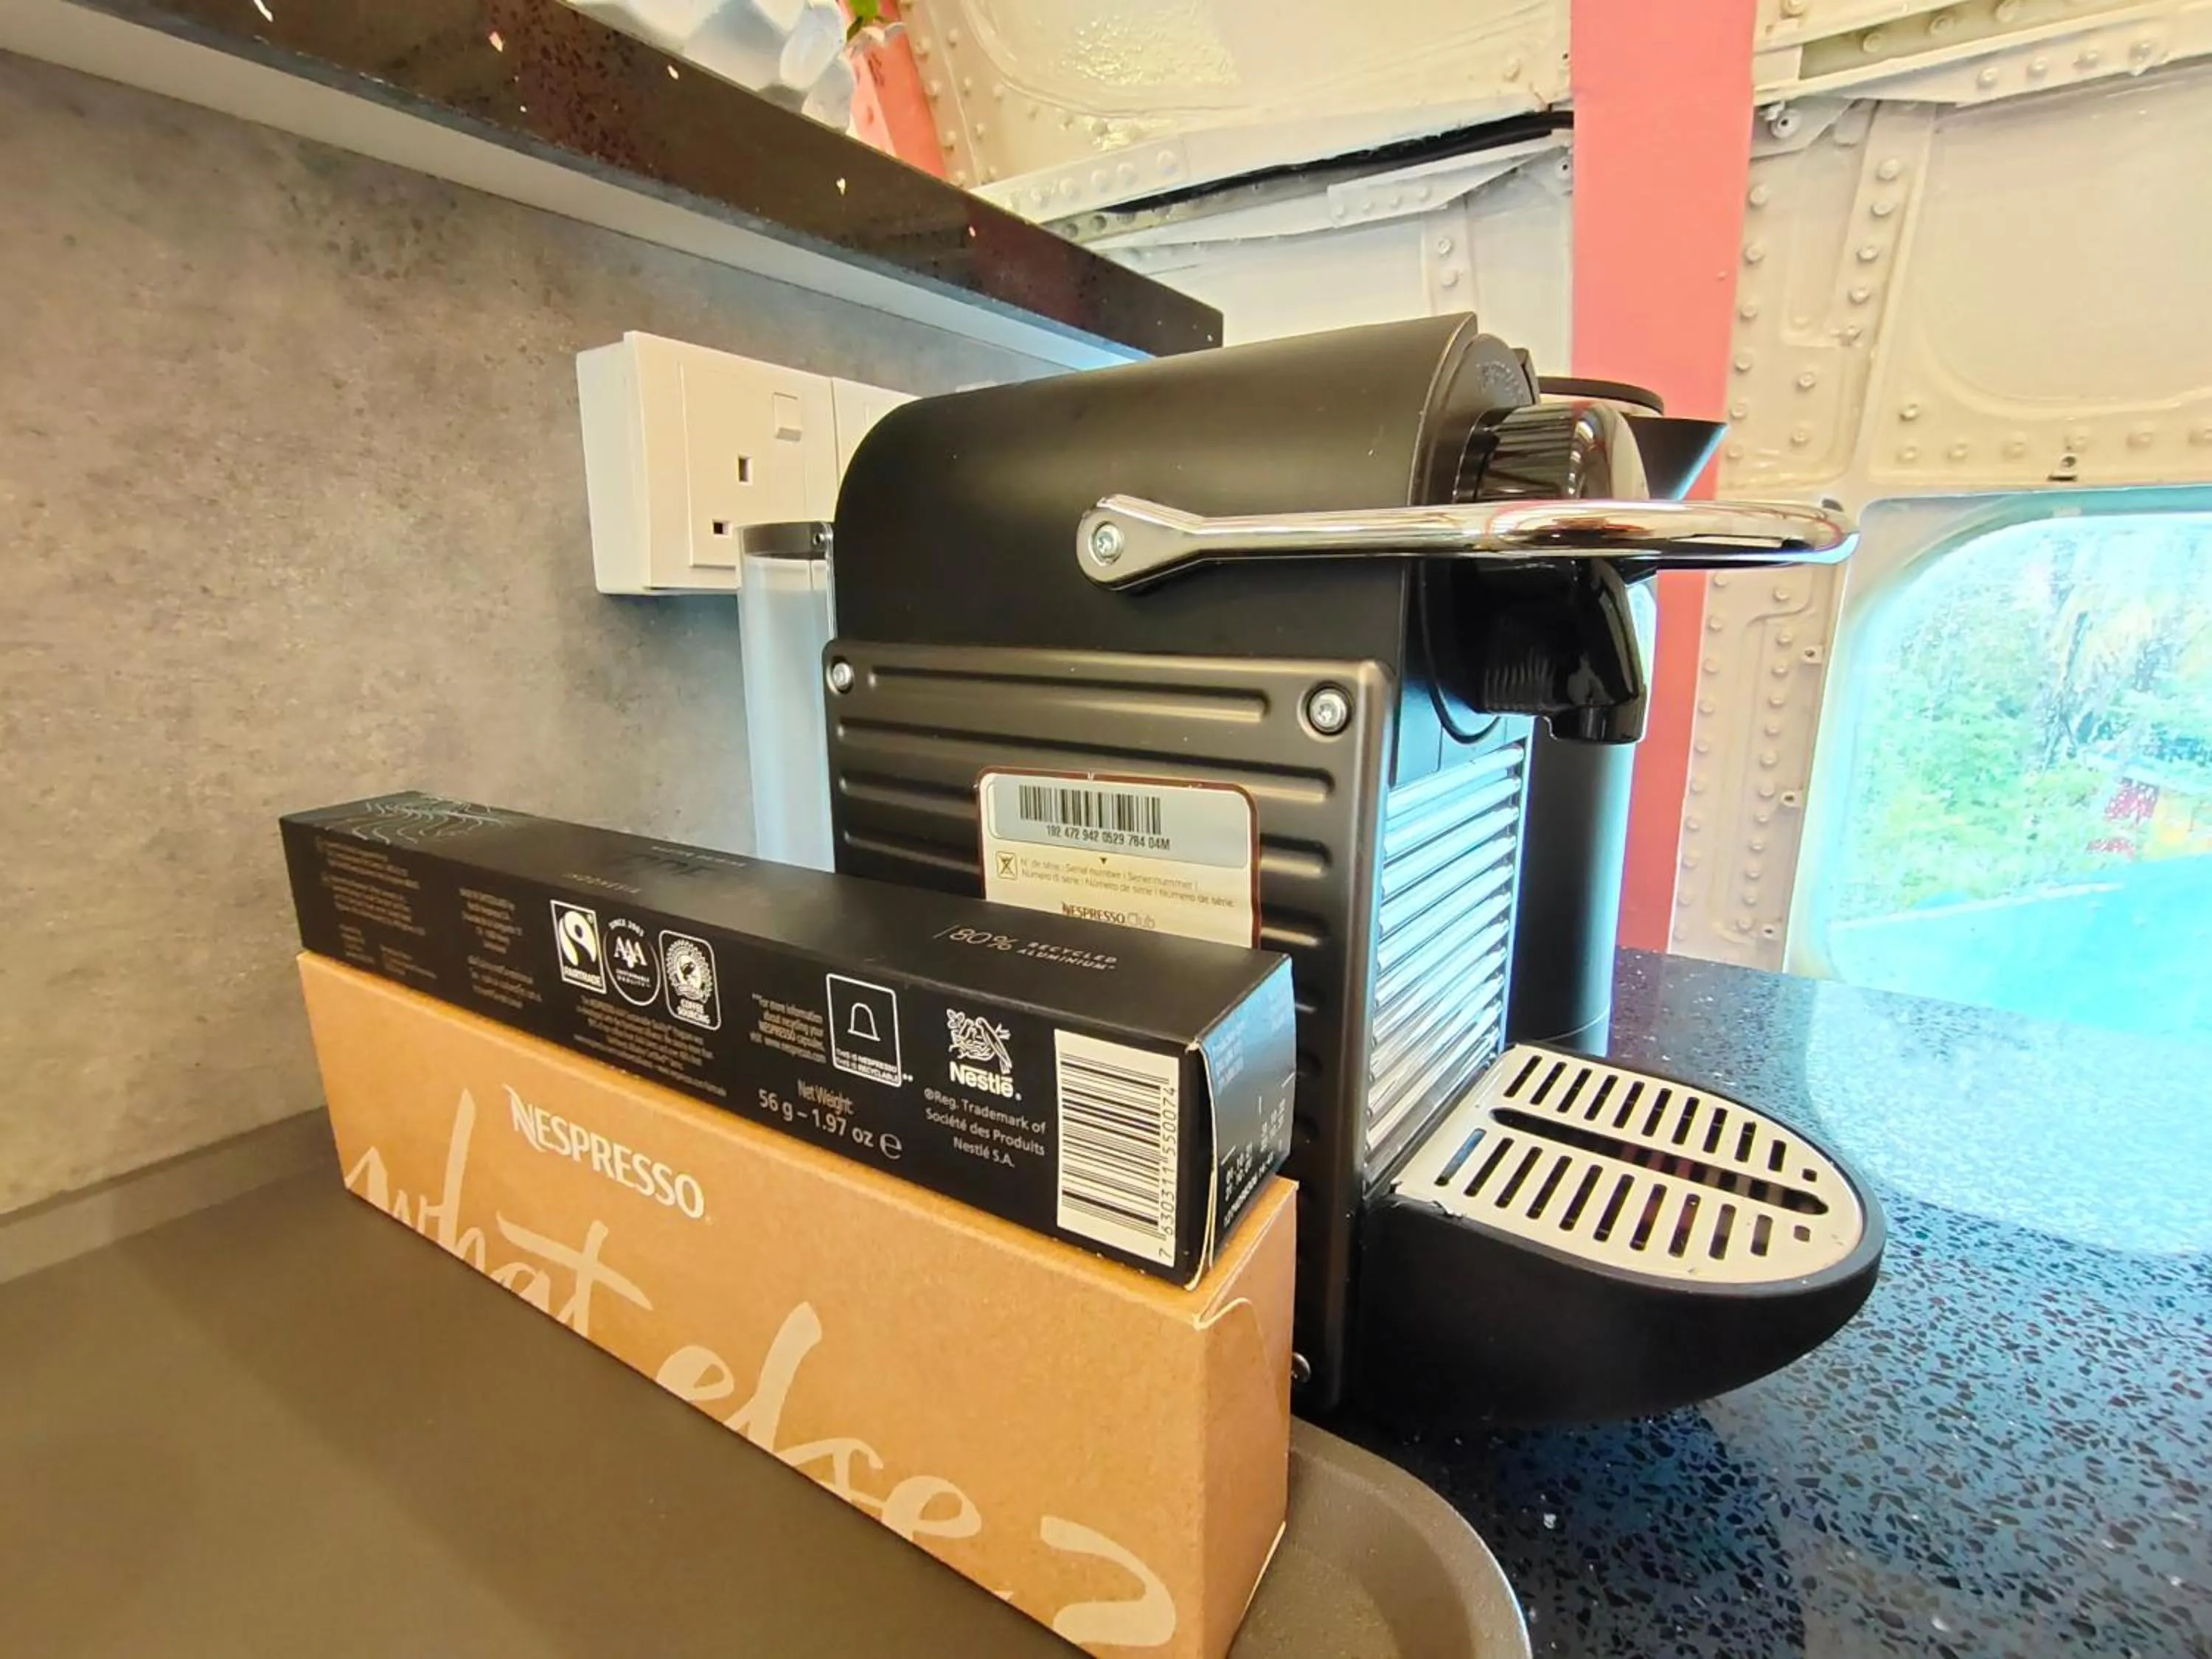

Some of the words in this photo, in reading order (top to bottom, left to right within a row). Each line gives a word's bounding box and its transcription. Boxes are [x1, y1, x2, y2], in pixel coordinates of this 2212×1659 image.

[1061, 900, 1125, 925] NESPRESSO
[1026, 942, 1118, 964] RECYCLED
[758, 1088, 779, 1111] 56
[782, 1102, 793, 1121] g
[812, 1108, 847, 1136] 1.97
[852, 1127, 874, 1148] oz
[925, 1107, 967, 1131] Société
[970, 1121, 990, 1139] des
[992, 1129, 1046, 1156] Produits
[961, 1098, 1030, 1130] Trademark
[1032, 1121, 1047, 1134] of
[501, 1082, 705, 1219] NESPRESSO
